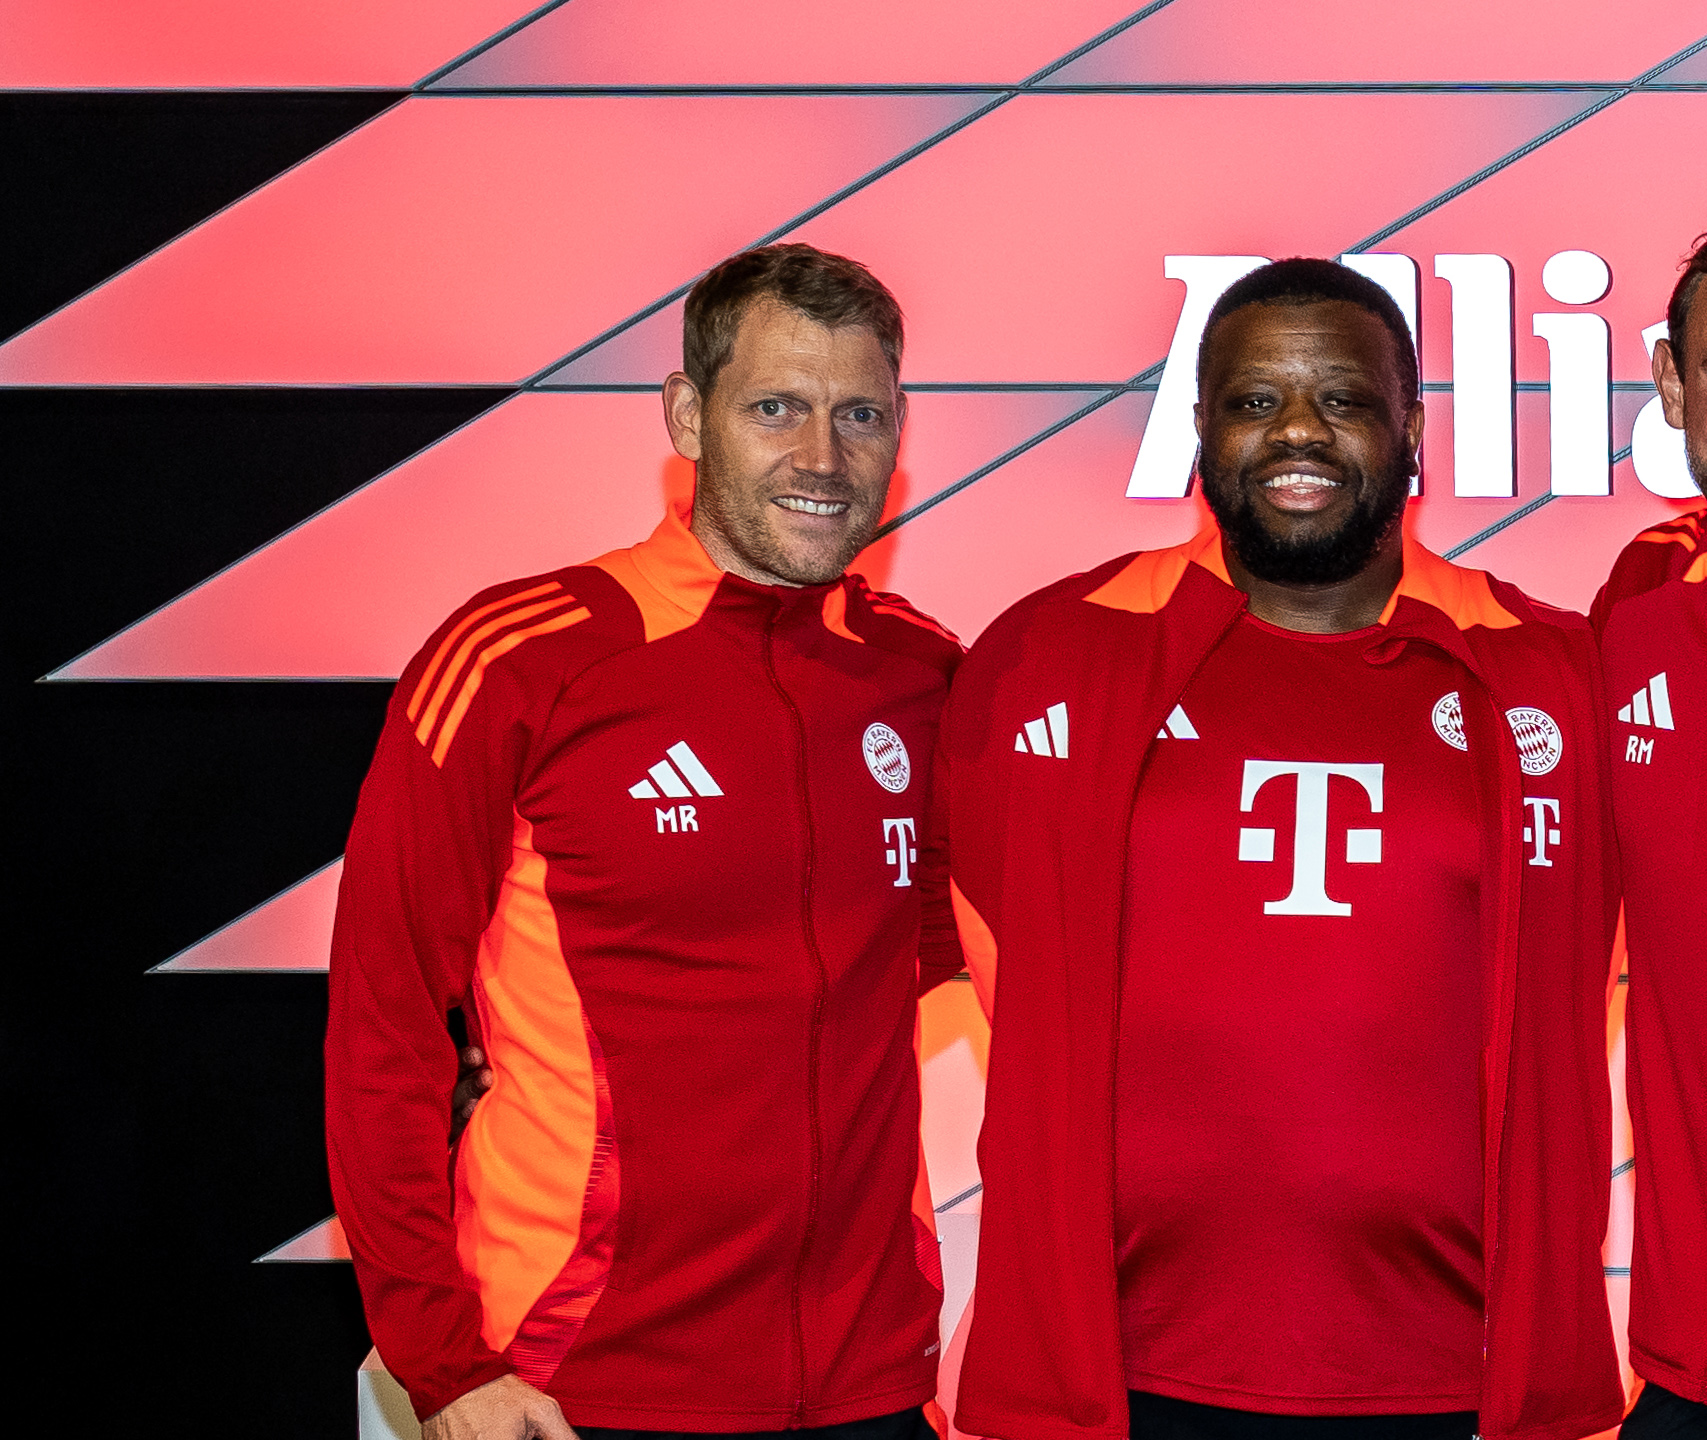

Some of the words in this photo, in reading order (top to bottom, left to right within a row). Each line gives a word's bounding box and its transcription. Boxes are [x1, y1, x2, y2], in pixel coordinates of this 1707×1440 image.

[1511, 713, 1554, 735] BAYERN
[1625, 735, 1654, 765] RM
[655, 804, 700, 834] MR
